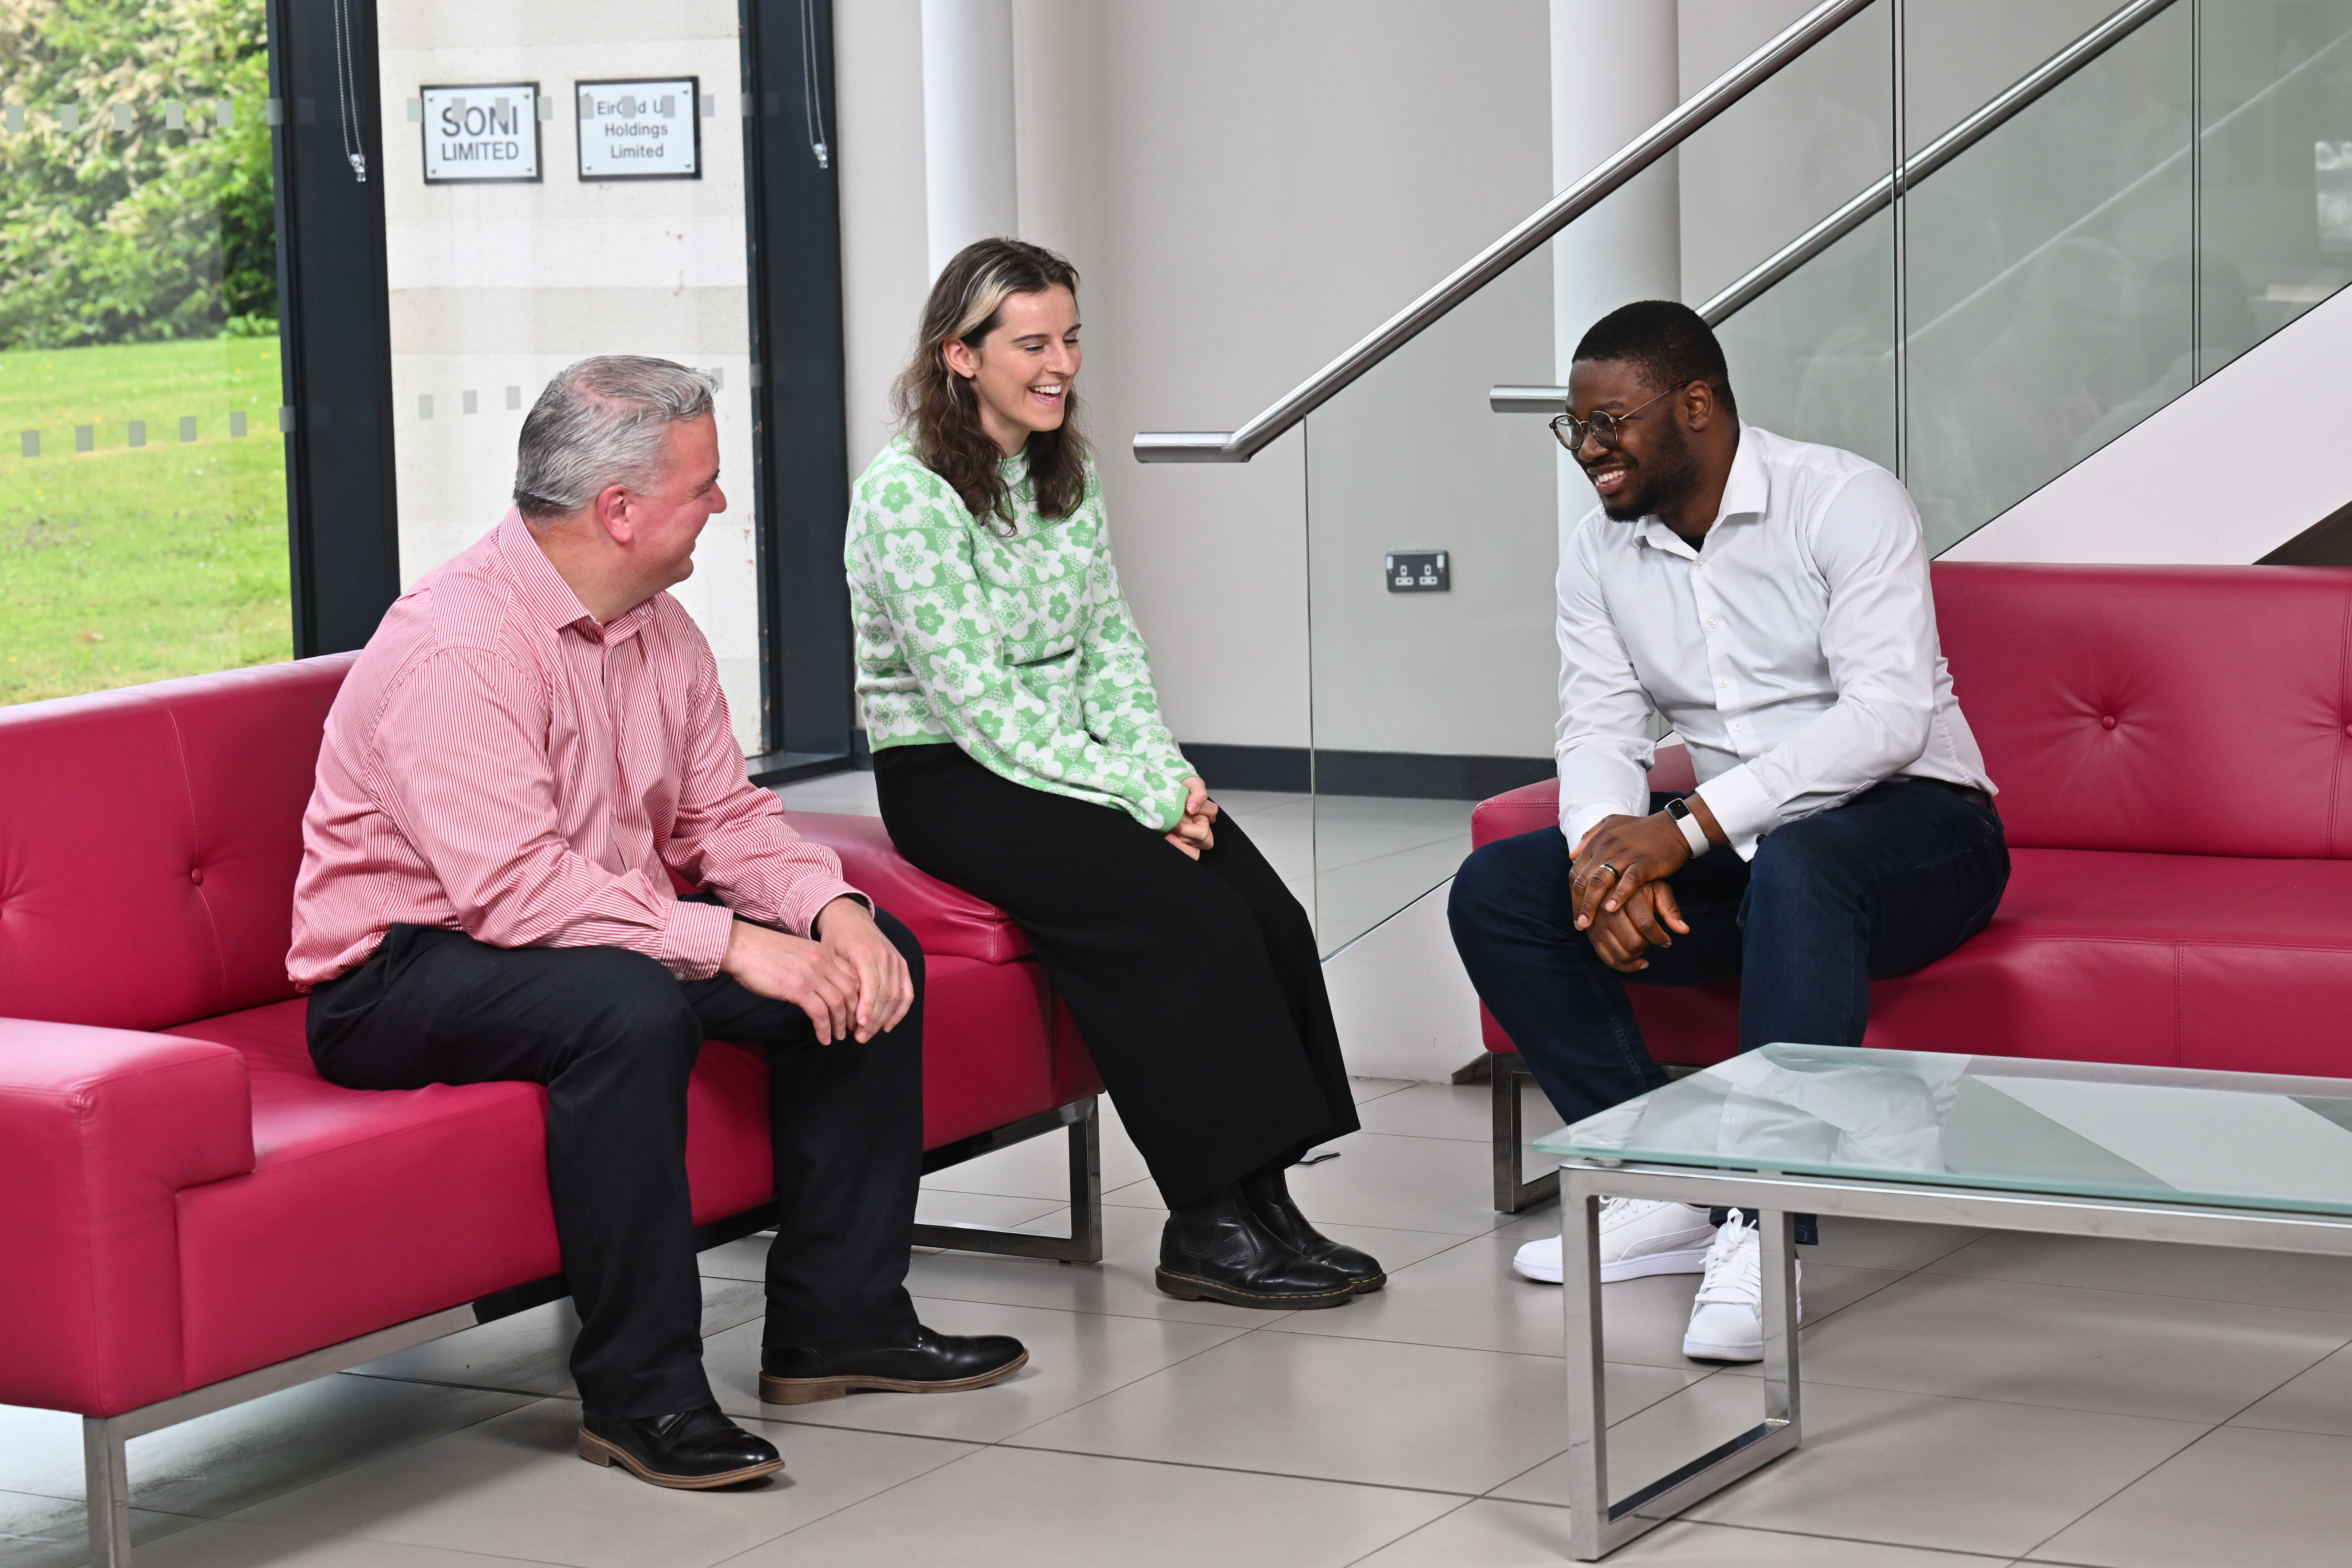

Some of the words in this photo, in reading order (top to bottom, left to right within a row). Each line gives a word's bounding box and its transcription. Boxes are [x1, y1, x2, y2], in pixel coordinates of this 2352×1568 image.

[597, 100, 646, 114] Eirid
[653, 100, 665, 113] U
[442, 106, 518, 137] SONI
[605, 122, 668, 138] Holdings
[442, 141, 518, 160] LIMITED
[610, 143, 664, 158] Limited
